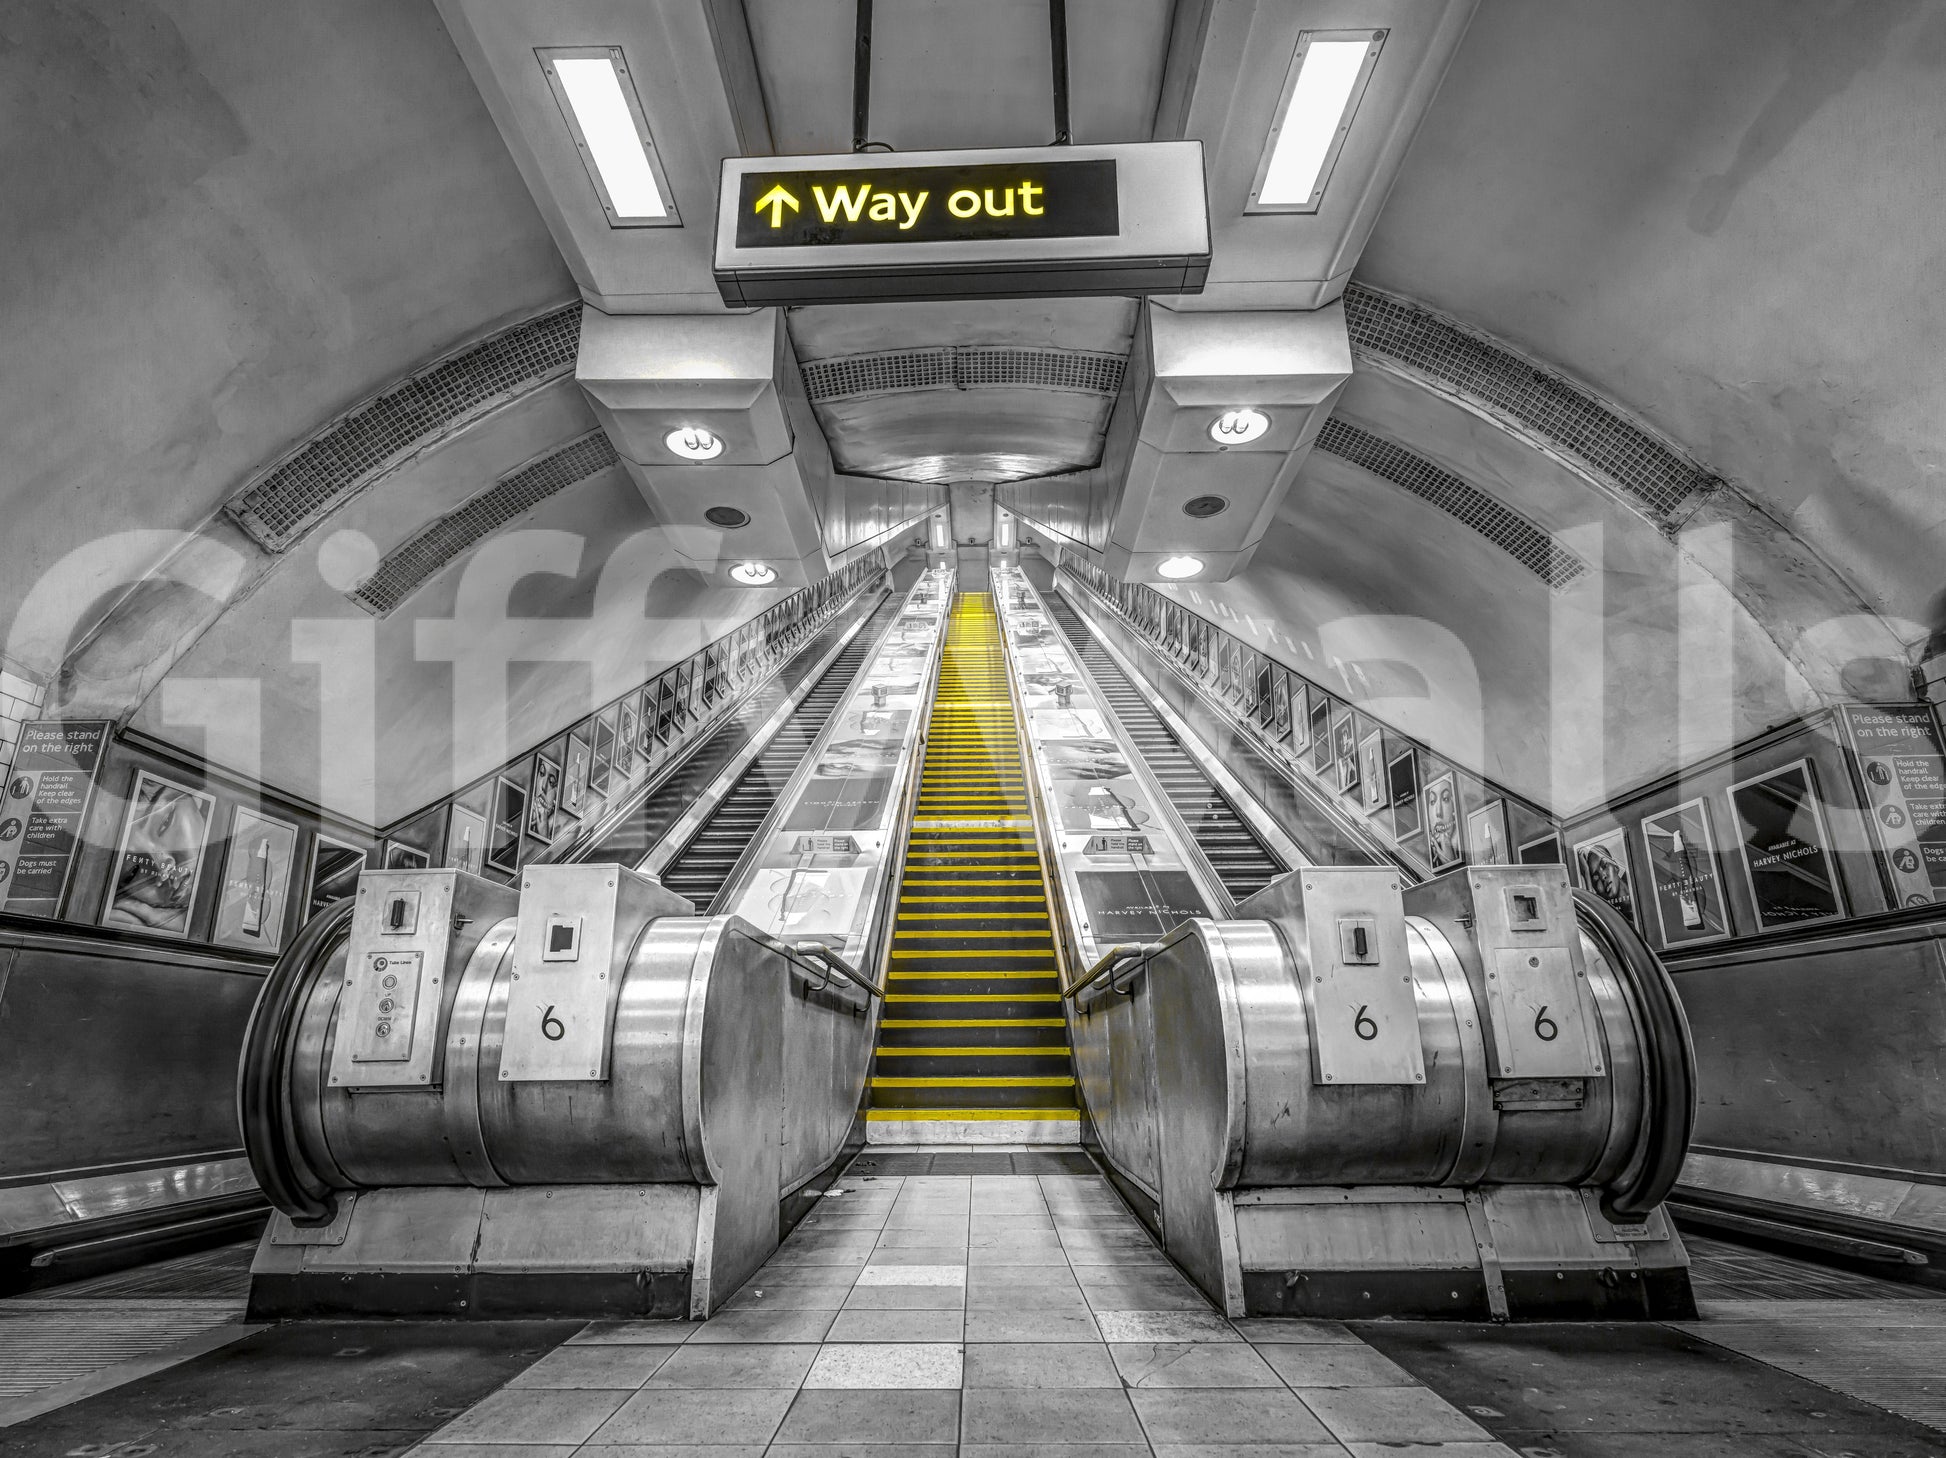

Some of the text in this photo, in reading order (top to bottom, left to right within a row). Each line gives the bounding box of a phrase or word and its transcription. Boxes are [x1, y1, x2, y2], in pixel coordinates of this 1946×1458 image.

[812, 181, 1044, 229] Way out
[1852, 713, 1930, 724] Please stand
[25, 729, 101, 740] Please stand
[1857, 726, 1932, 739] on the right
[22, 742, 94, 755] on the right
[1898, 767, 1929, 775] handrail
[40, 782, 68, 790] handrail
[57, 789, 75, 797] clear
[60, 797, 82, 806] edges
[28, 824, 44, 832] care
[1753, 844, 1819, 868] HARVEY NICHOLS
[1923, 847, 1944, 856] Dogs
[18, 860, 37, 868] Dogs
[1925, 855, 1937, 863] be
[27, 867, 53, 875] carried
[542, 1005, 565, 1041] 6
[1354, 1005, 1378, 1041] 6
[1534, 1005, 1558, 1041] 6
